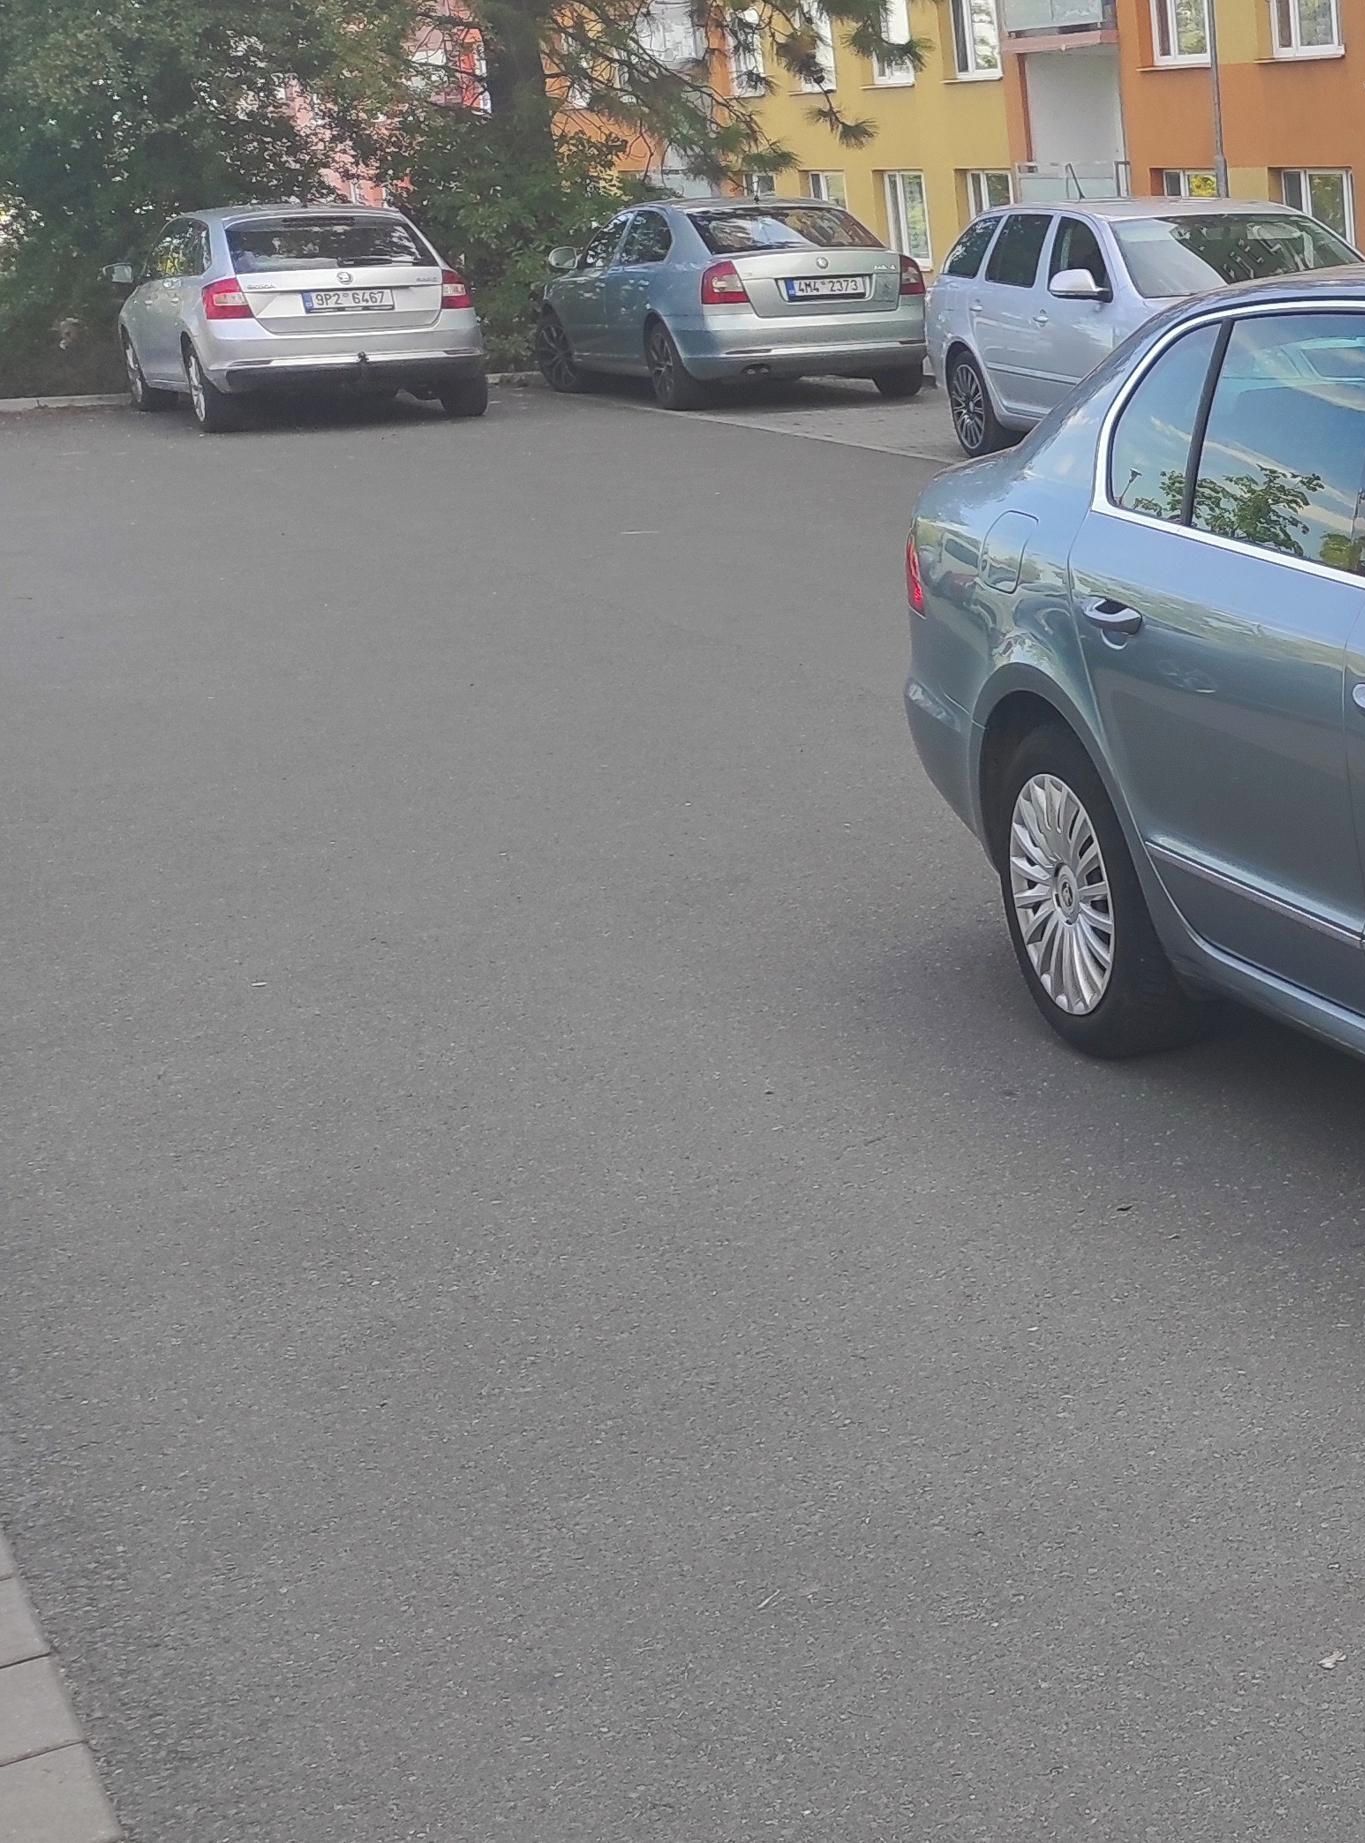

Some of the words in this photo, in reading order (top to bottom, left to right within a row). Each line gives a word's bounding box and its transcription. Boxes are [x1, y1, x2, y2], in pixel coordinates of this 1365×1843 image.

[798, 281, 820, 293] 4M4
[828, 279, 859, 292] 2373
[315, 292, 342, 306] 9P2
[351, 291, 385, 304] 6467
